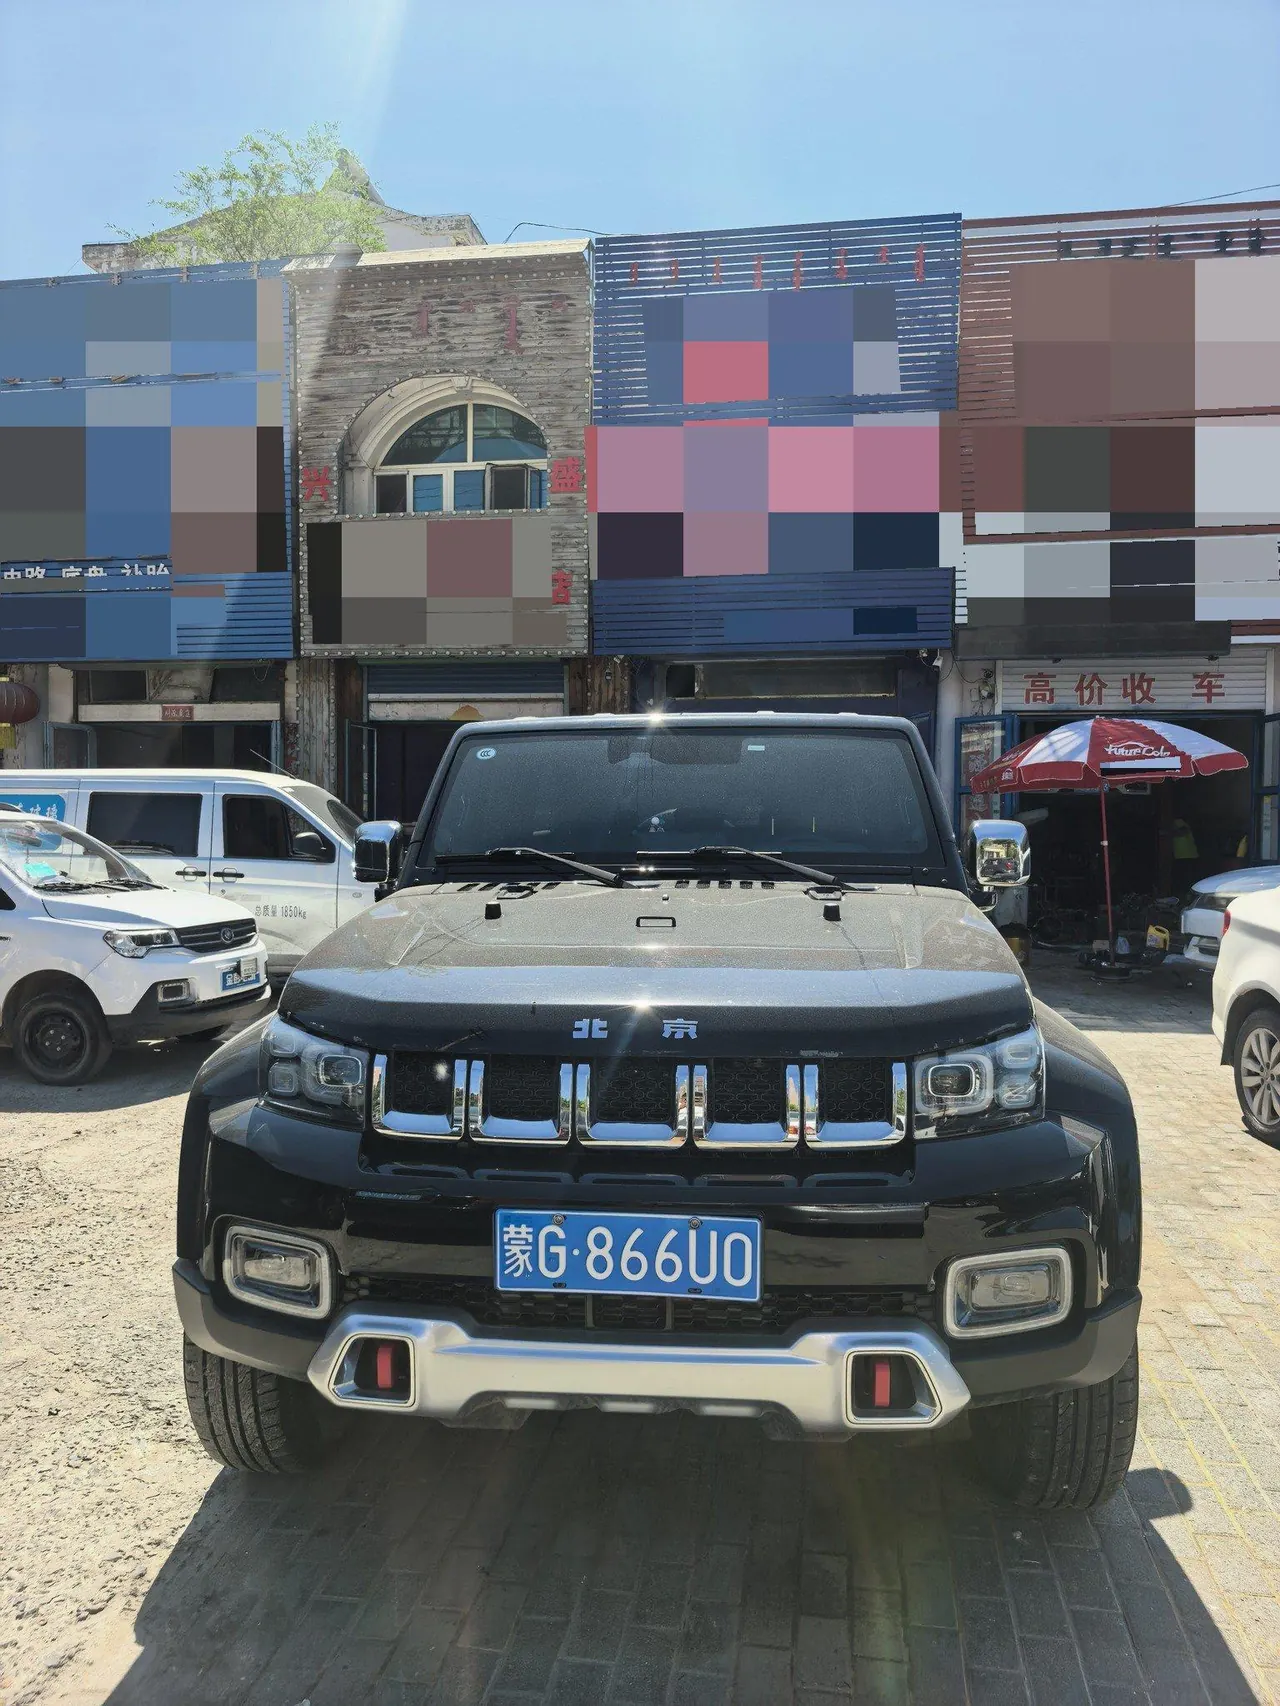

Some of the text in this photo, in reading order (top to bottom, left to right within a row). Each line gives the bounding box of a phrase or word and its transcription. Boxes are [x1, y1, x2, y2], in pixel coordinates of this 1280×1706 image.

[300, 466, 332, 502] 兴
[1023, 671, 1226, 706] 高价收车
[572, 1017, 699, 1040] 北京
